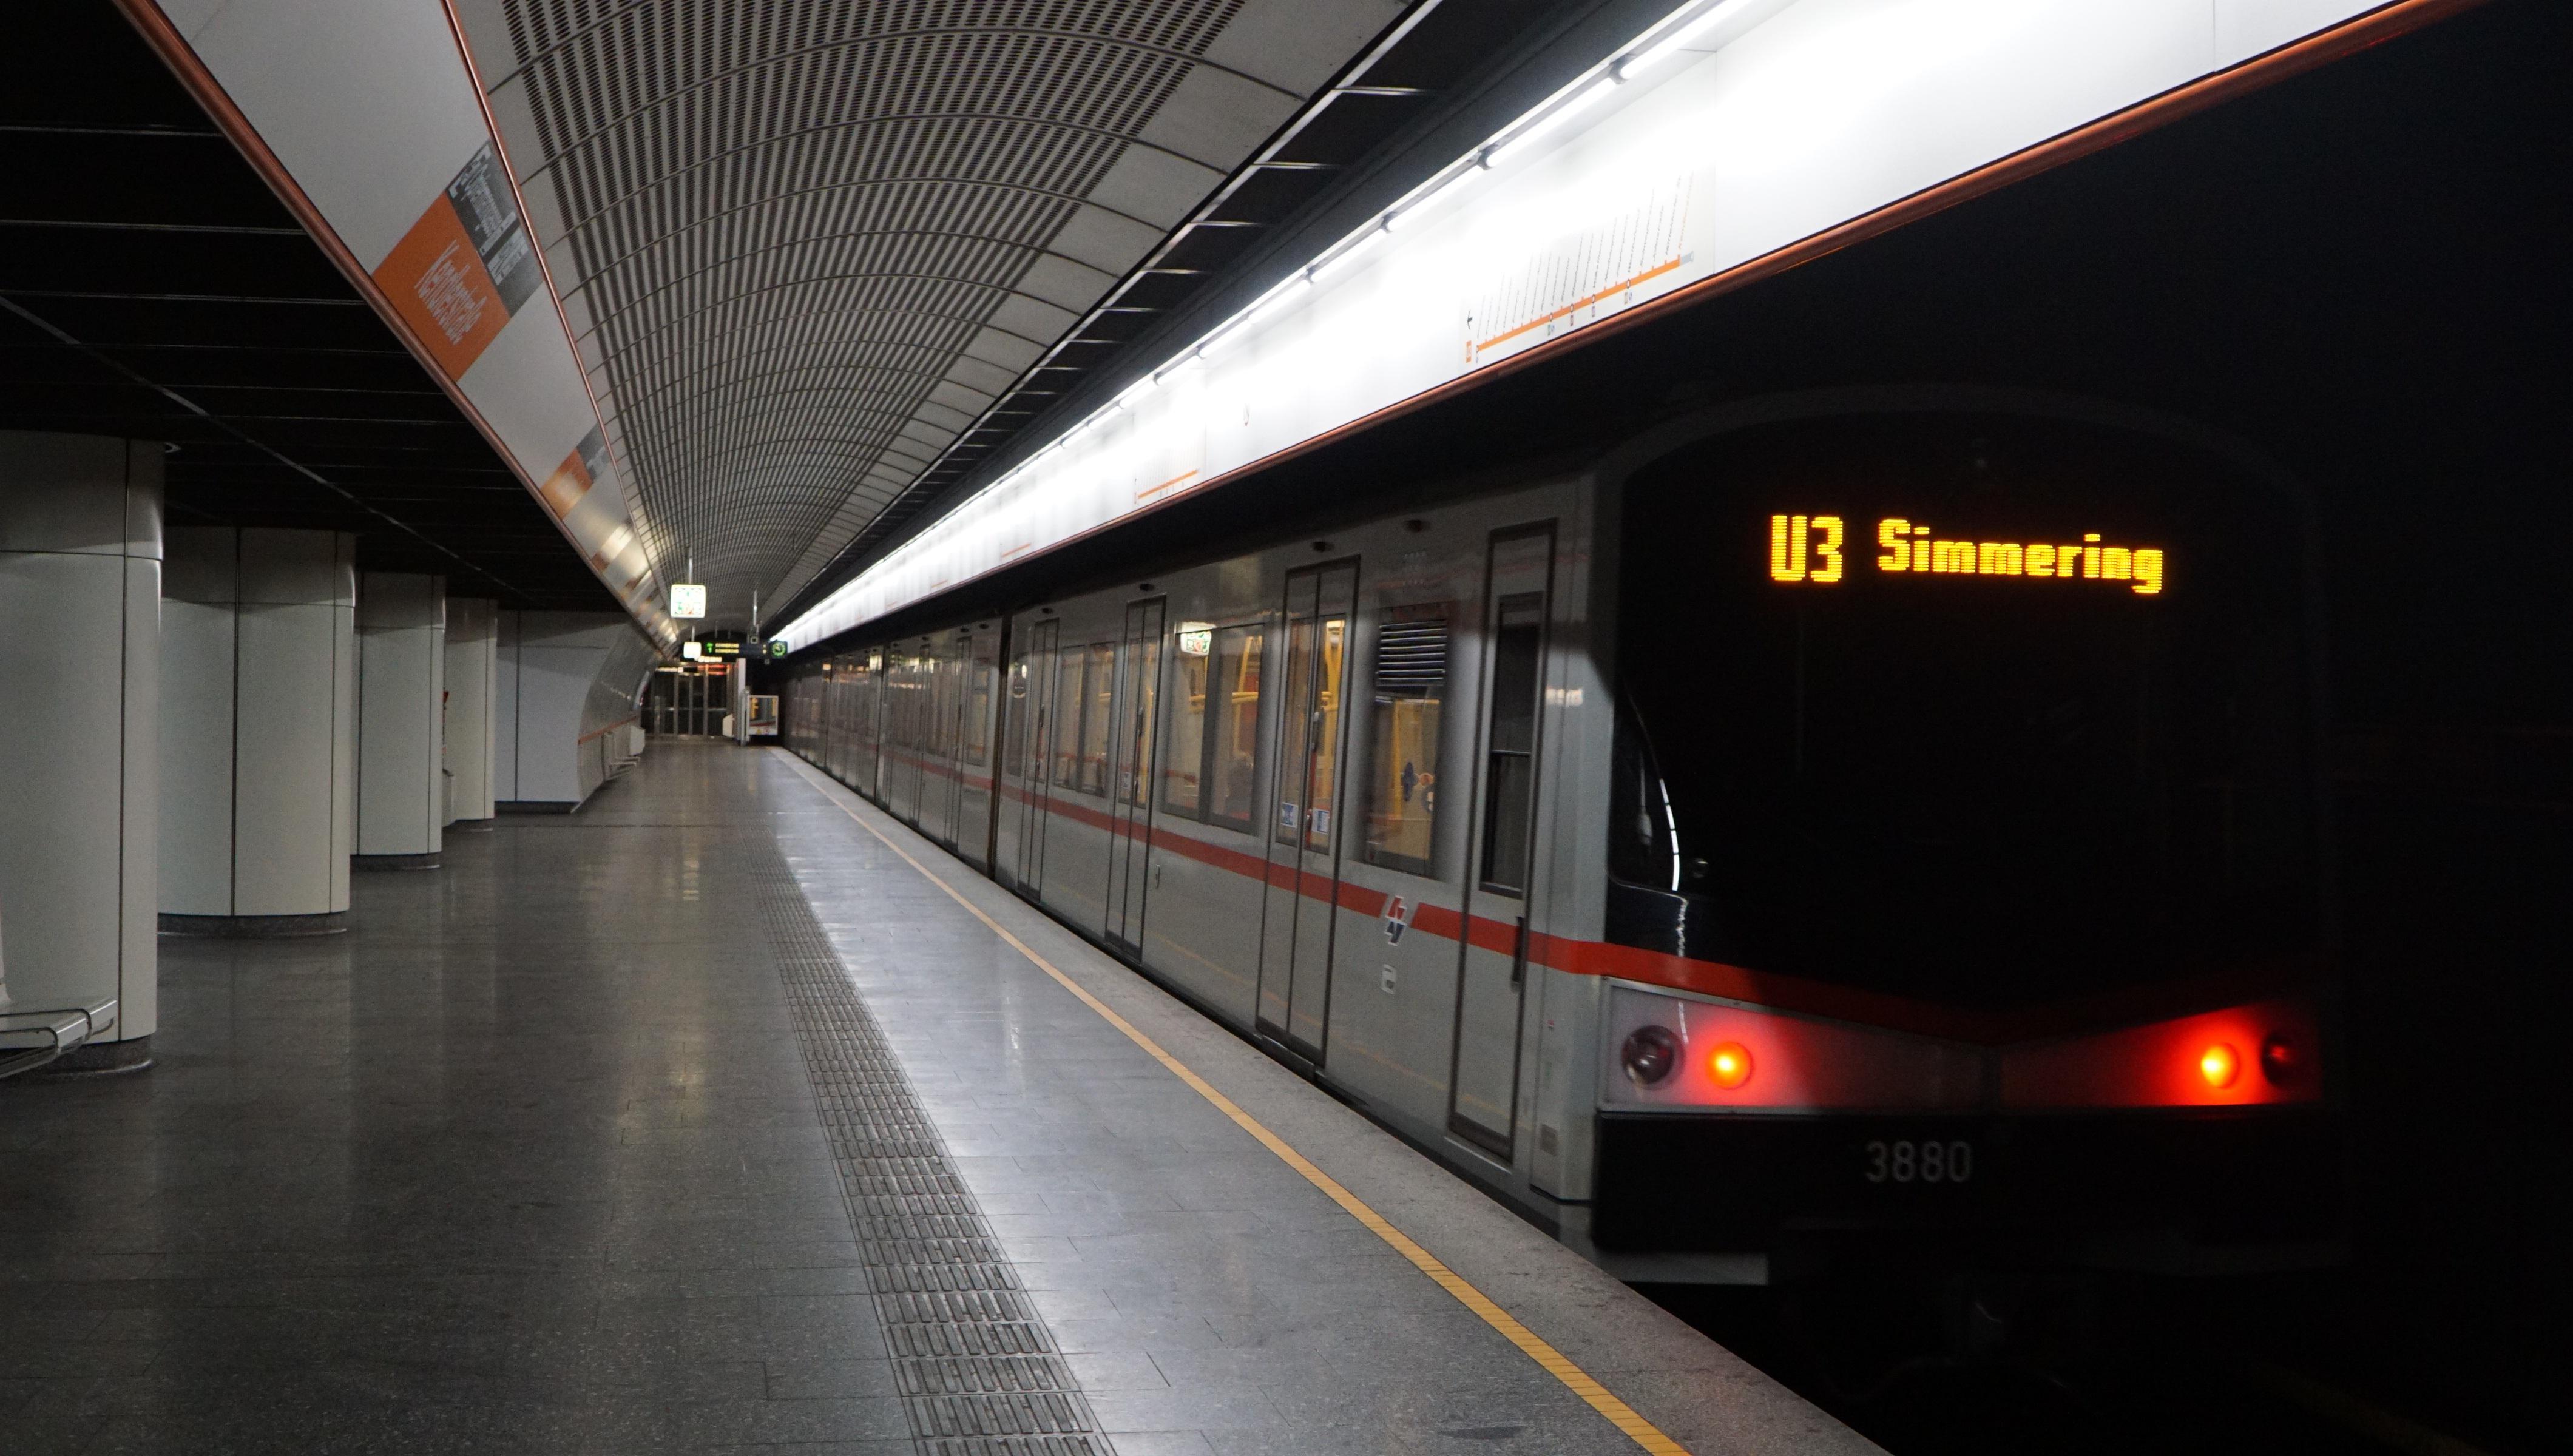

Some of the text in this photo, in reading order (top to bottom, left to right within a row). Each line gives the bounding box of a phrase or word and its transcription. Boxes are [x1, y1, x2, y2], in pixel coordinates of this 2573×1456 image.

[1771, 515, 2163, 593] U3 Simmering
[1865, 1140, 1972, 1182] 3880
